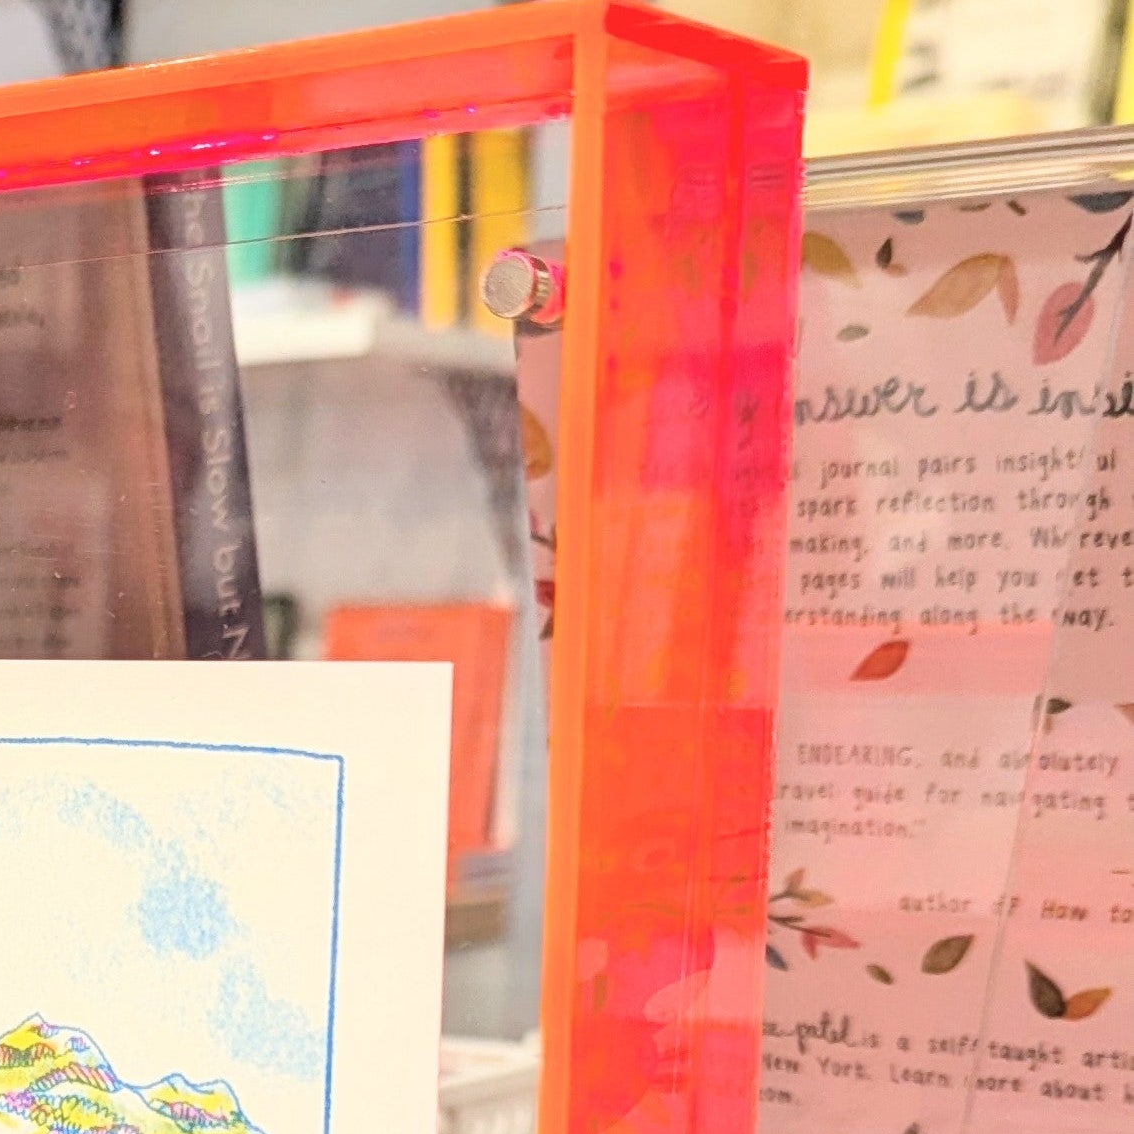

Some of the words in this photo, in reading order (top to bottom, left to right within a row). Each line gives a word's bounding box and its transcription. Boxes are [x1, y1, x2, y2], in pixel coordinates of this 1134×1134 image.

[794, 376, 938, 424] nswer
[953, 372, 1018, 413] is
[201, 427, 233, 531] Slow
[821, 456, 899, 489] journal
[918, 457, 977, 482] pairs
[797, 496, 857, 521] spark
[876, 490, 995, 514] reflection
[889, 530, 927, 553] and
[214, 540, 243, 615] but
[801, 572, 862, 600] pages
[881, 568, 916, 590] will
[935, 566, 977, 592] help
[998, 570, 1039, 592] you
[784, 602, 902, 635] erstanding
[920, 605, 978, 636] along
[1000, 603, 1036, 625] the
[941, 748, 979, 770] and
[777, 782, 836, 800] ravel
[852, 782, 905, 812] guide
[926, 781, 962, 803] for
[898, 893, 970, 912] author
[1041, 900, 1089, 921] How
[896, 1036, 910, 1051] a
[889, 1062, 950, 1086] Learn
[1039, 1080, 1105, 1101] about
